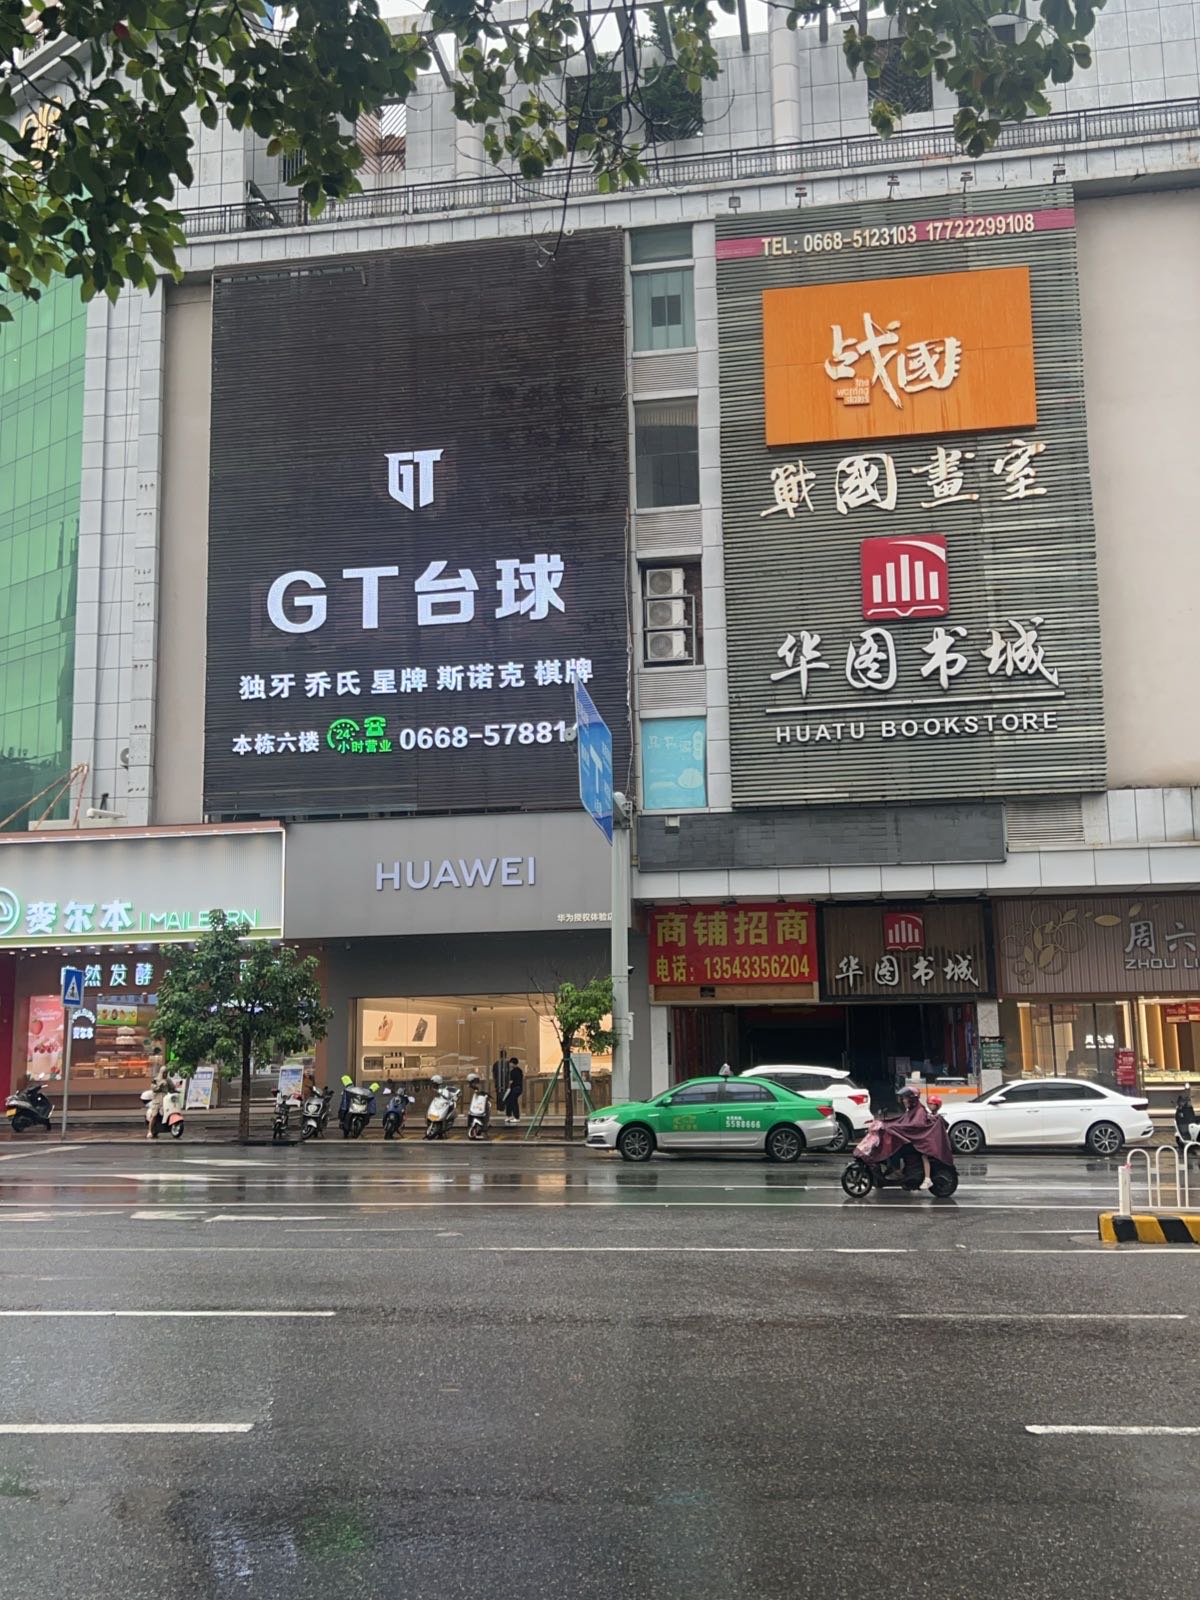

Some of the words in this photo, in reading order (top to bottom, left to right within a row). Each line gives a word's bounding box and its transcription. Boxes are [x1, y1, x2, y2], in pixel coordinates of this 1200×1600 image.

[761, 236, 799, 257] TEL:
[803, 224, 917, 253] 0668-5123103
[925, 213, 1035, 242] 17722299108
[384, 449, 444, 511] GT
[770, 616, 1060, 698] 华图书城
[239, 673, 296, 701] 独牙
[305, 671, 361, 698] 乔氏
[371, 666, 428, 695] 星牌
[436, 662, 525, 692] 斯诺克
[534, 657, 594, 687] 棋牌
[232, 731, 320, 756] 本栋六楼
[336, 729, 350, 740] 24
[400, 720, 577, 751] 0668-57881
[776, 722, 866, 744] HUATU
[882, 712, 1058, 739] BOOKSTORE
[337, 739, 392, 754] 小时营业
[376, 856, 535, 891] HUAWEI
[654, 909, 809, 947] 商铺招商
[1125, 920, 1197, 954] 周六
[703, 954, 810, 980] 13543356204
[835, 954, 980, 988] 华图书城
[1125, 958, 1176, 970] ZHOU
